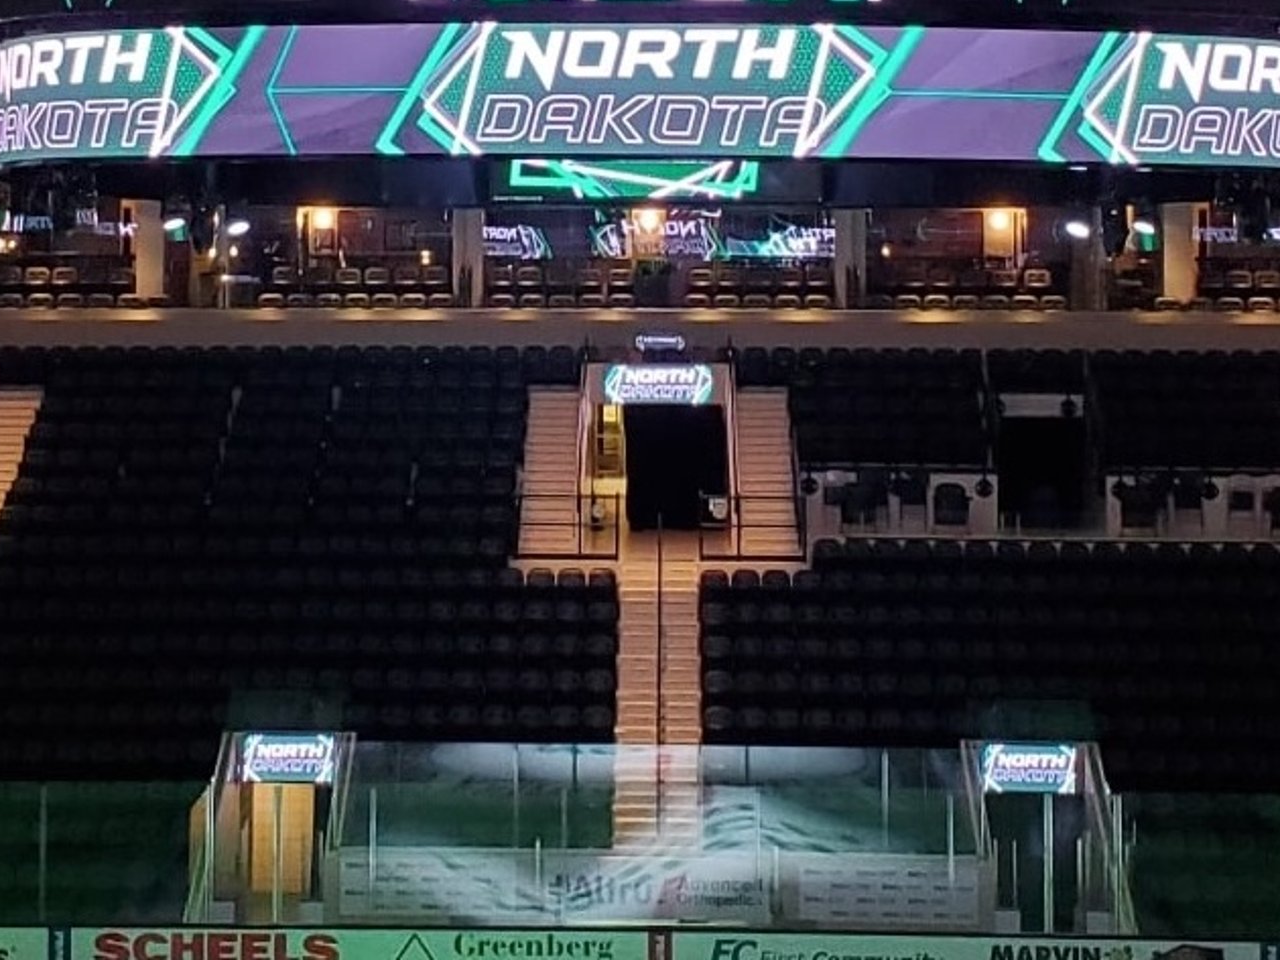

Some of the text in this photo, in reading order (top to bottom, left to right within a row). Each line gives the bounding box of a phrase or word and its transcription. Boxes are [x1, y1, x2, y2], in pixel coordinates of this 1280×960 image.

[501, 30, 797, 92] NORTH
[477, 94, 826, 148] DAKOTA
[625, 368, 695, 385] NORTH
[257, 744, 323, 758] NORTH
[998, 753, 1067, 769] NORTH
[94, 933, 340, 960] SCHEELS
[454, 933, 613, 960] Greenberg
[711, 939, 758, 960] FC
